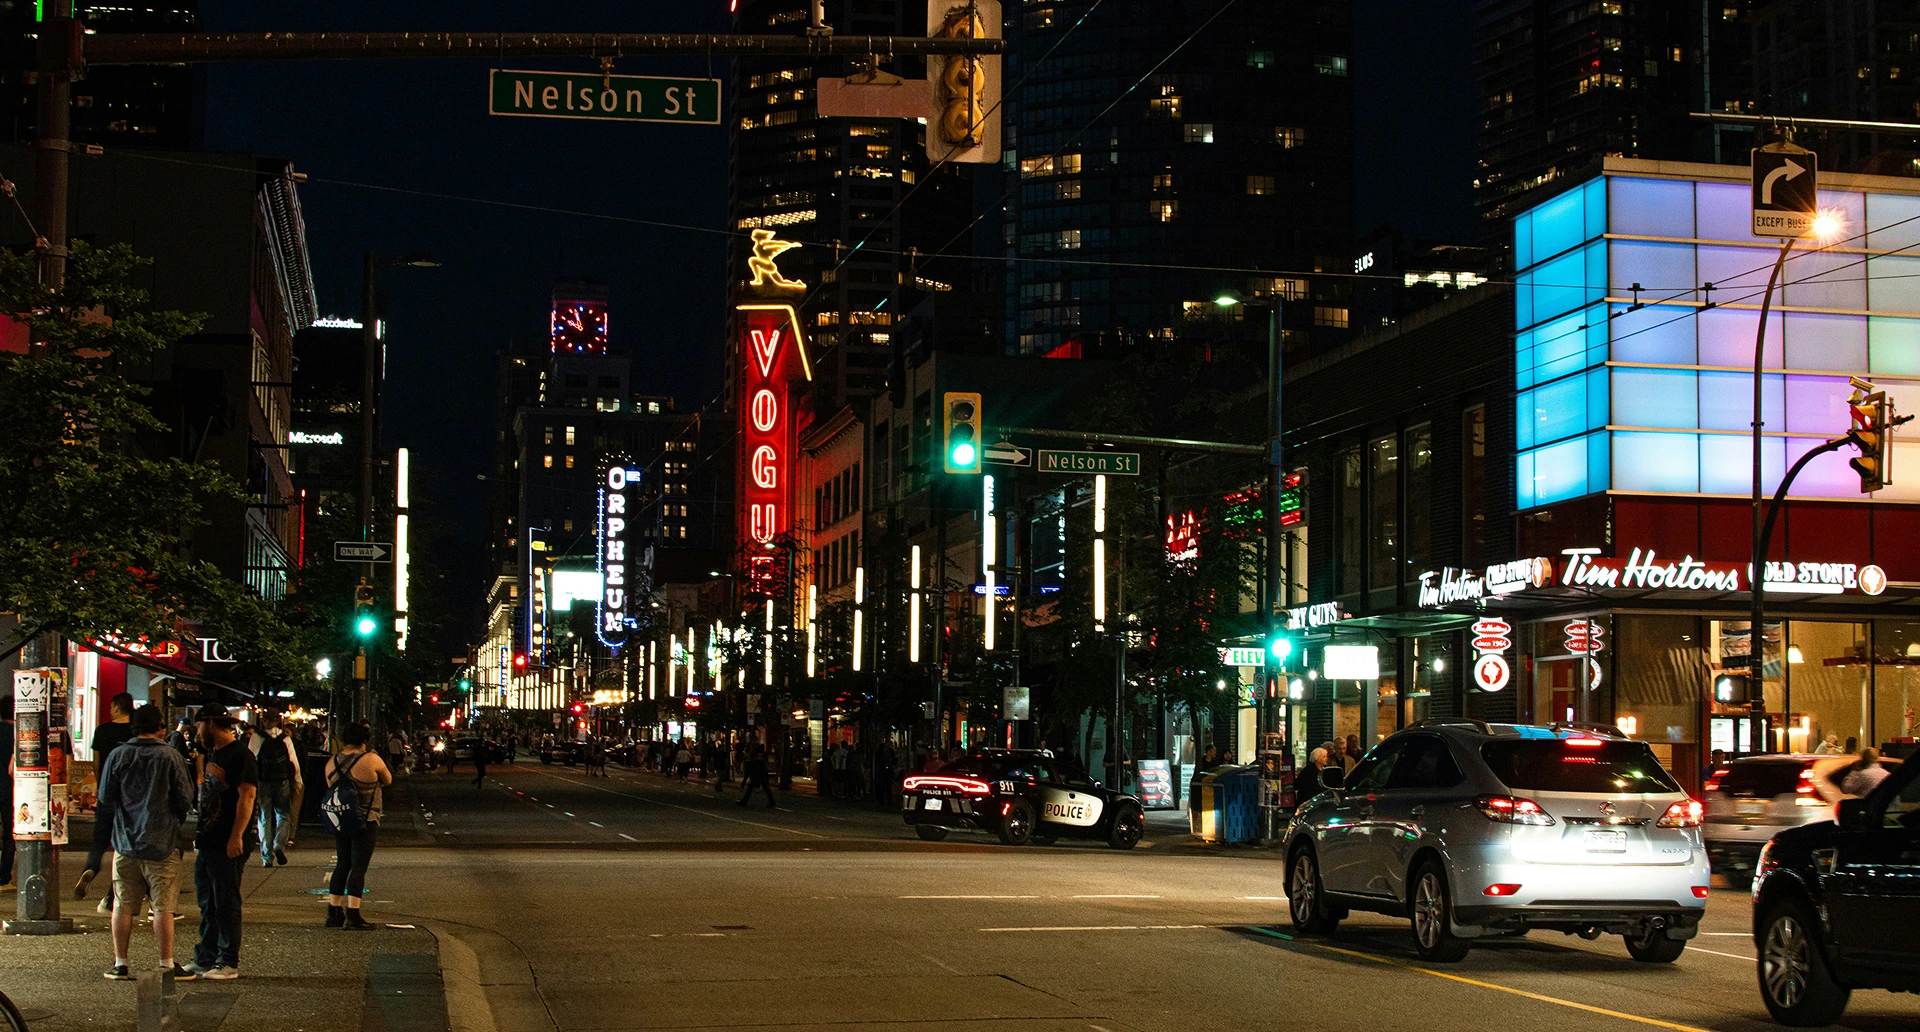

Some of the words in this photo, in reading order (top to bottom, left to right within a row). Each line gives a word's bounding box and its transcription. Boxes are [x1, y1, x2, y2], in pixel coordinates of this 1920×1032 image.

[514, 80, 642, 113] Nelson
[664, 87, 696, 116] St
[1756, 216, 1784, 228] EXCEPT
[1787, 218, 1808, 229] BUSE
[289, 431, 343, 445] Microsoft
[751, 331, 780, 596] VOGUE
[1048, 454, 1107, 470] Nelson
[1115, 457, 1131, 471] St
[359, 548, 374, 556] WAY
[605, 467, 625, 632] ORPHEUM
[1561, 547, 1619, 588] Tim
[1622, 546, 1739, 592] Hortons
[1798, 561, 1857, 588] STONE
[1418, 570, 1440, 608] Tim
[1440, 566, 1483, 604] Hortons
[1309, 601, 1338, 628] GUYS
[999, 781, 1015, 792] 911
[1045, 802, 1084, 820] POLICE
